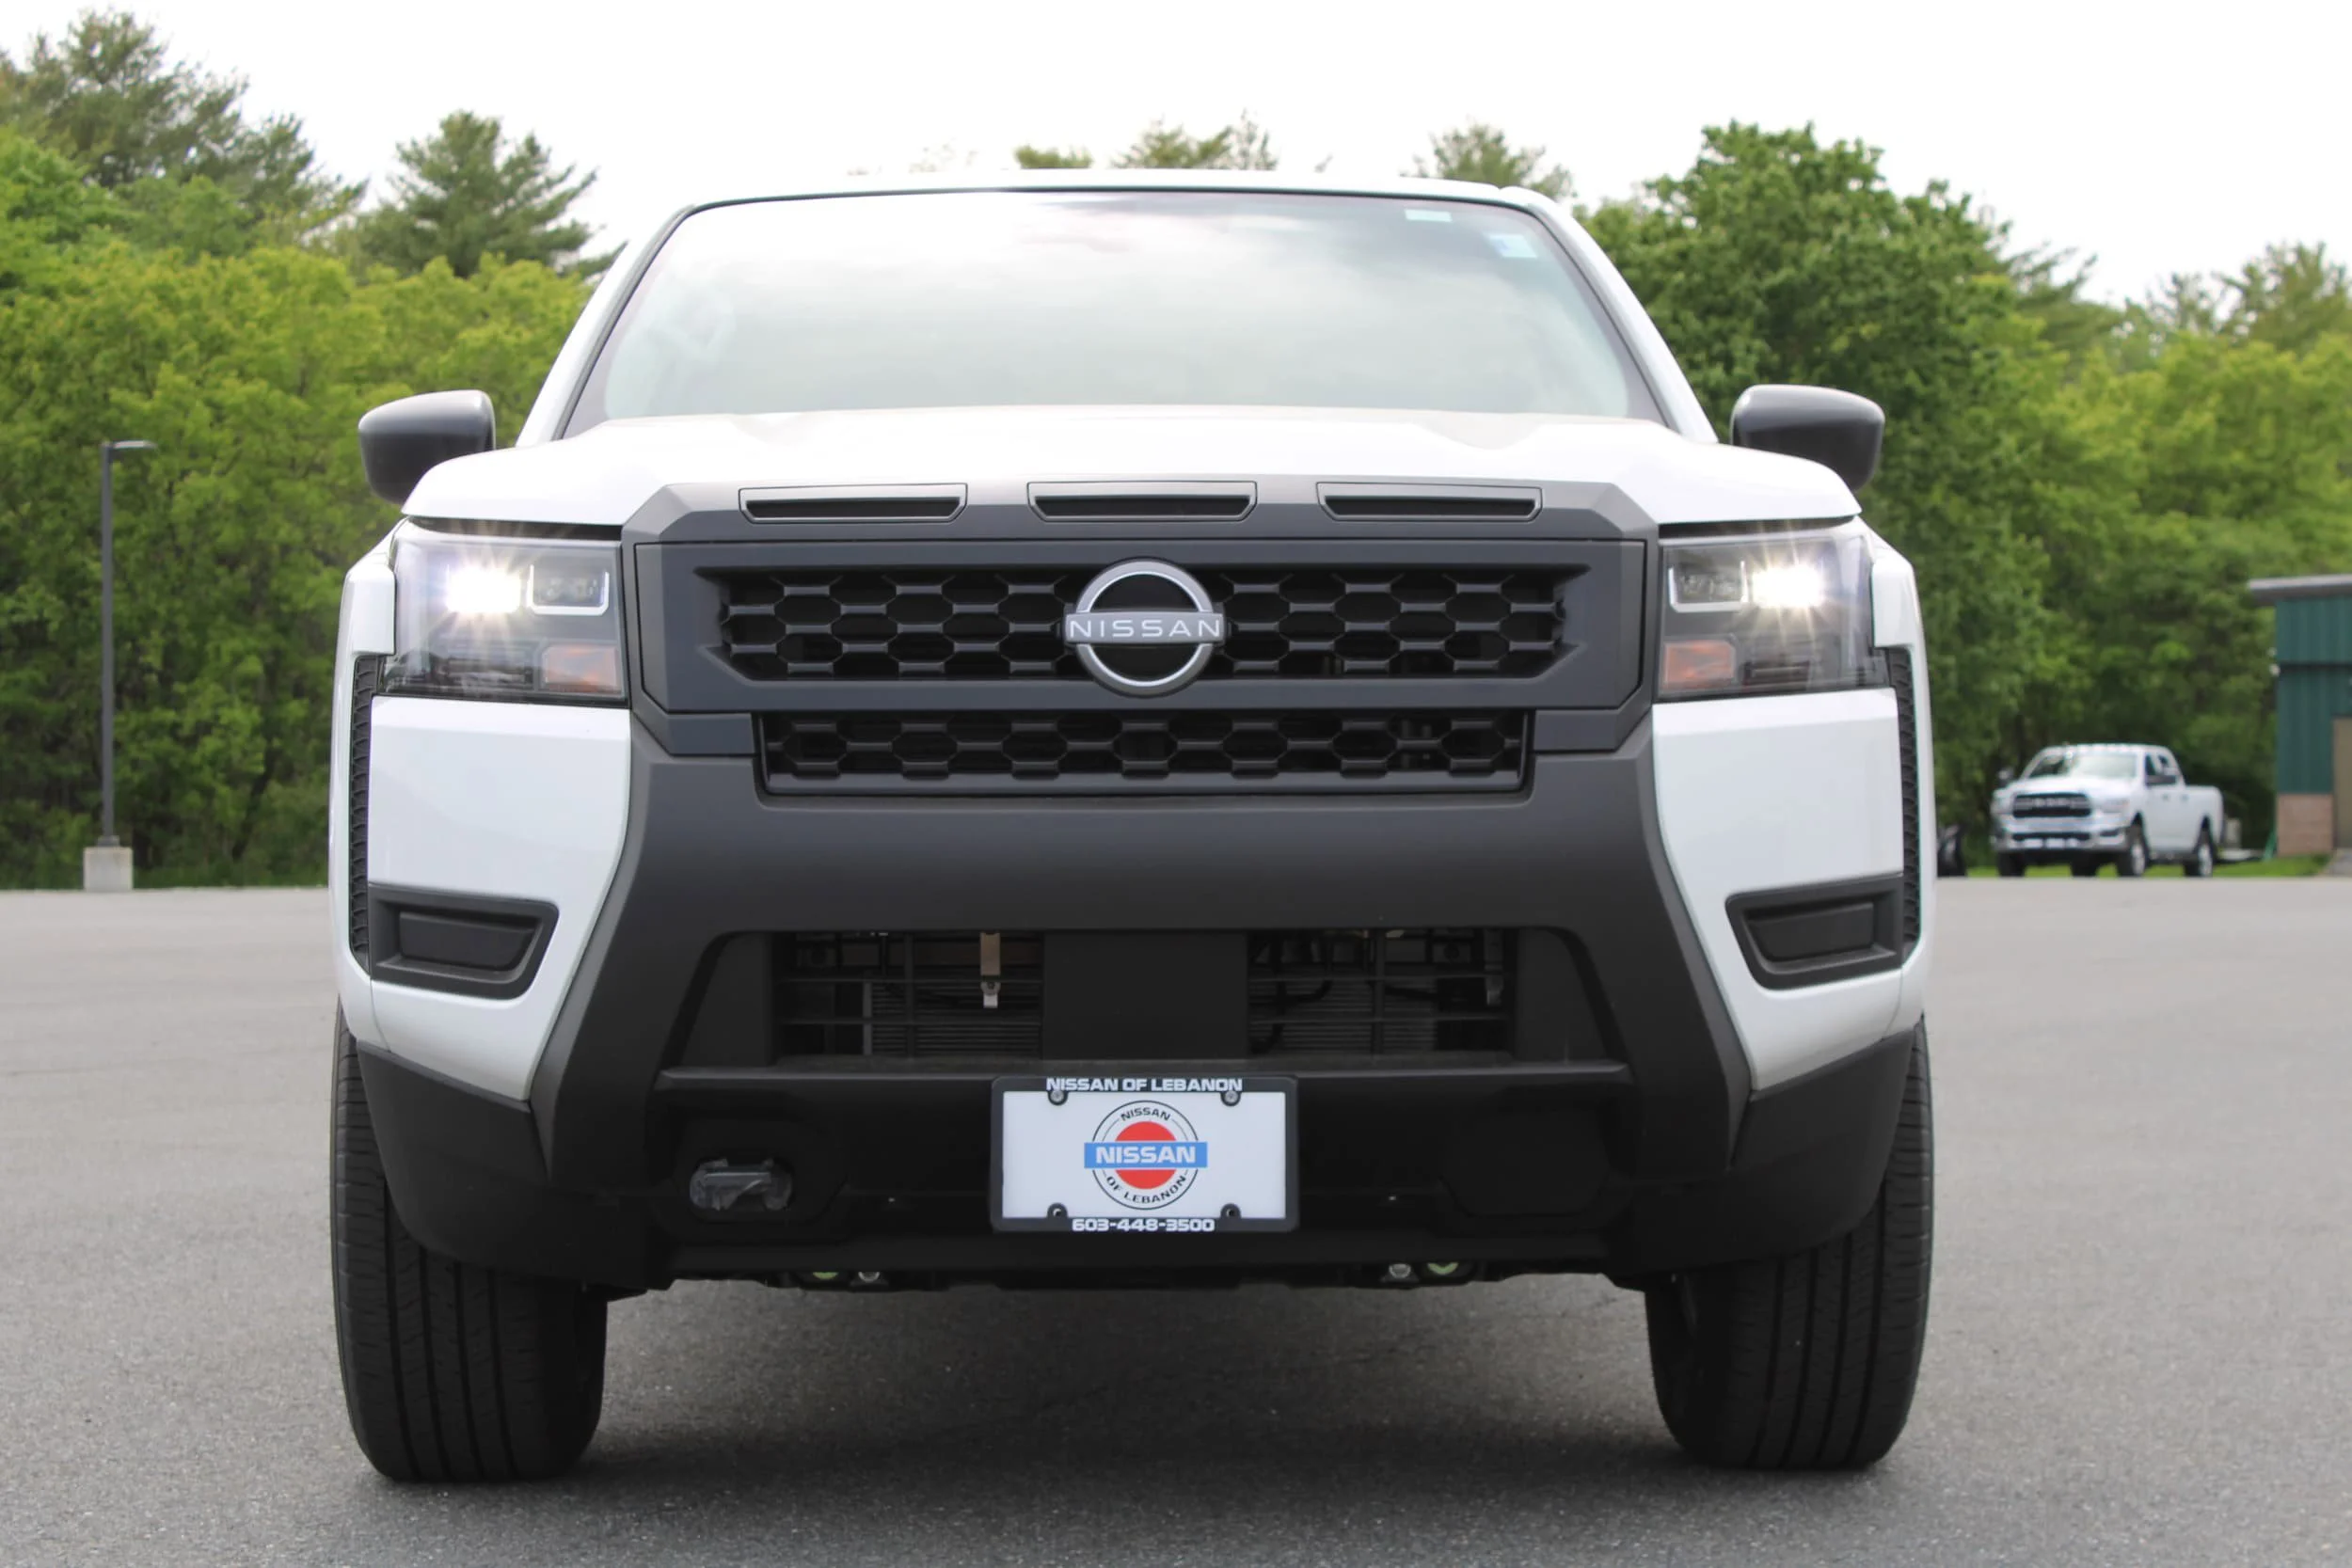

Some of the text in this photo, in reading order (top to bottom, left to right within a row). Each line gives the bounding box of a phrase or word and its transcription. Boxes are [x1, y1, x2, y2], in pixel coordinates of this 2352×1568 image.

[1069, 619, 1220, 638] NISSAN
[1046, 1078, 1243, 1092] NISSAN OF LEBANON
[1120, 1107, 1171, 1121] NISSAN
[1096, 1147, 1196, 1164] NISSAN
[1105, 1175, 1186, 1204] OF LEBANON
[1072, 1219, 1216, 1232] 603-448-3500
